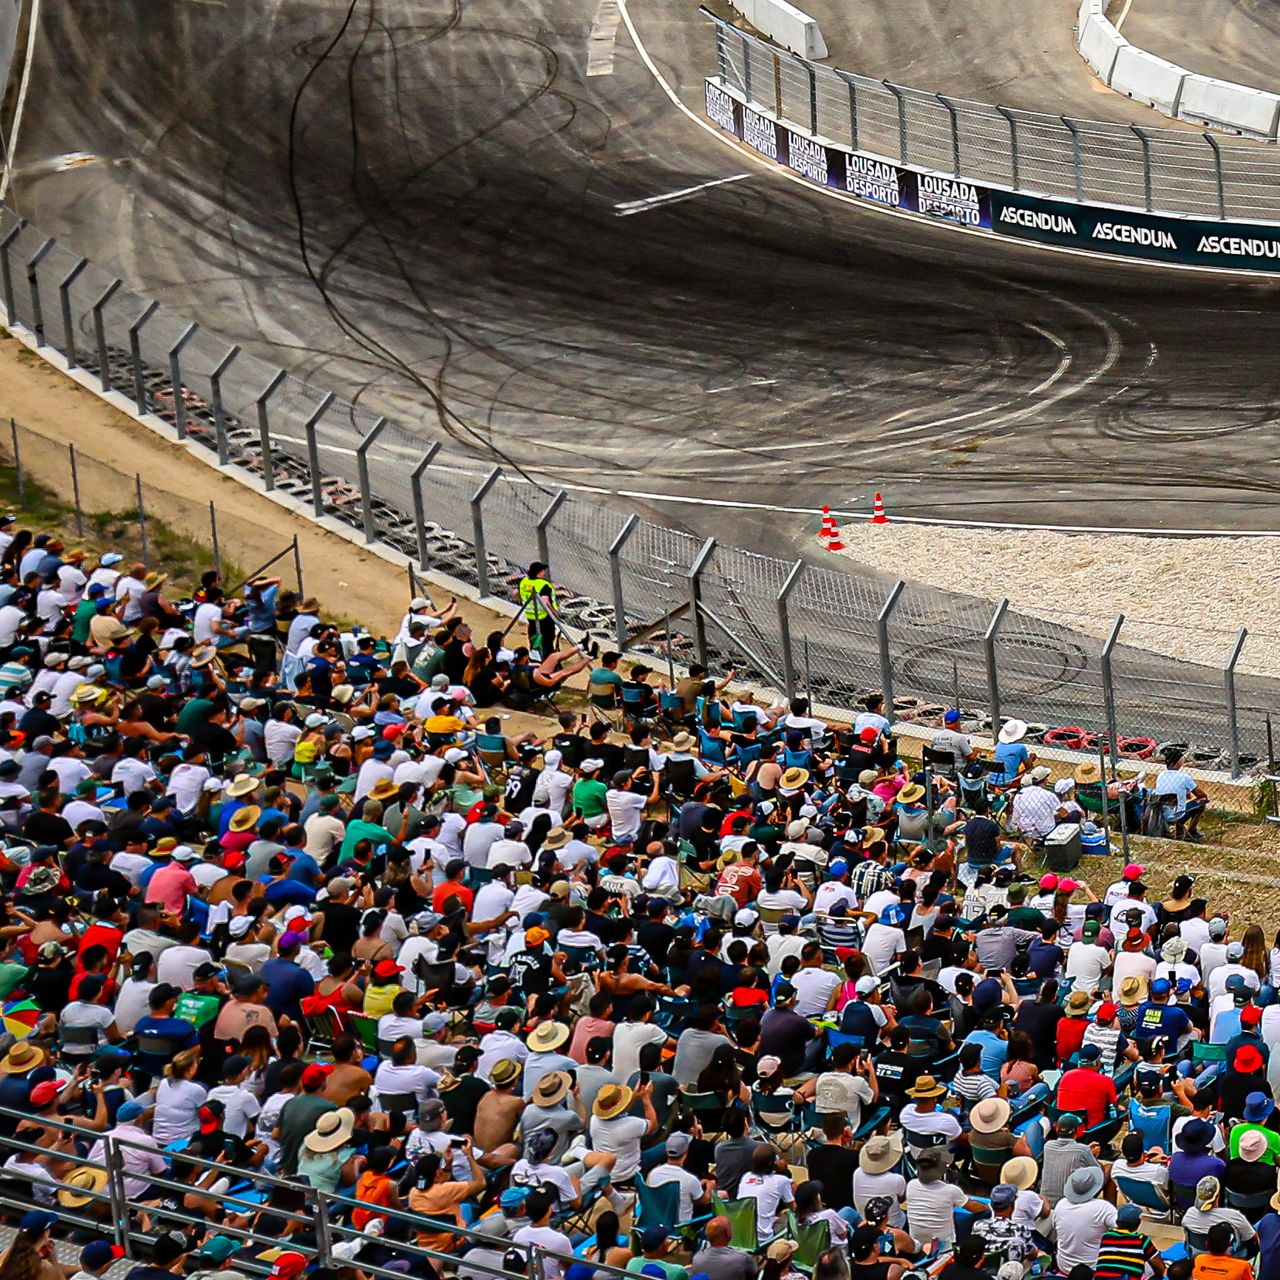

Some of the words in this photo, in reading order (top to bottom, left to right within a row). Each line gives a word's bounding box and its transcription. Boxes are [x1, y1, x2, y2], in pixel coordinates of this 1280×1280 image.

[742, 106, 776, 138] LOUSADA
[744, 130, 777, 159] DESPORTO
[789, 130, 827, 164] LOUSADA
[789, 153, 828, 185] DESPORTO
[845, 153, 899, 184] LOUSADA
[846, 177, 899, 205] DESPORTO
[917, 174, 978, 203] LOUSADA
[918, 198, 980, 226] DESPORTO
[1000, 205, 1077, 235] ASCENDUM
[1092, 221, 1176, 250] ASCENDUM
